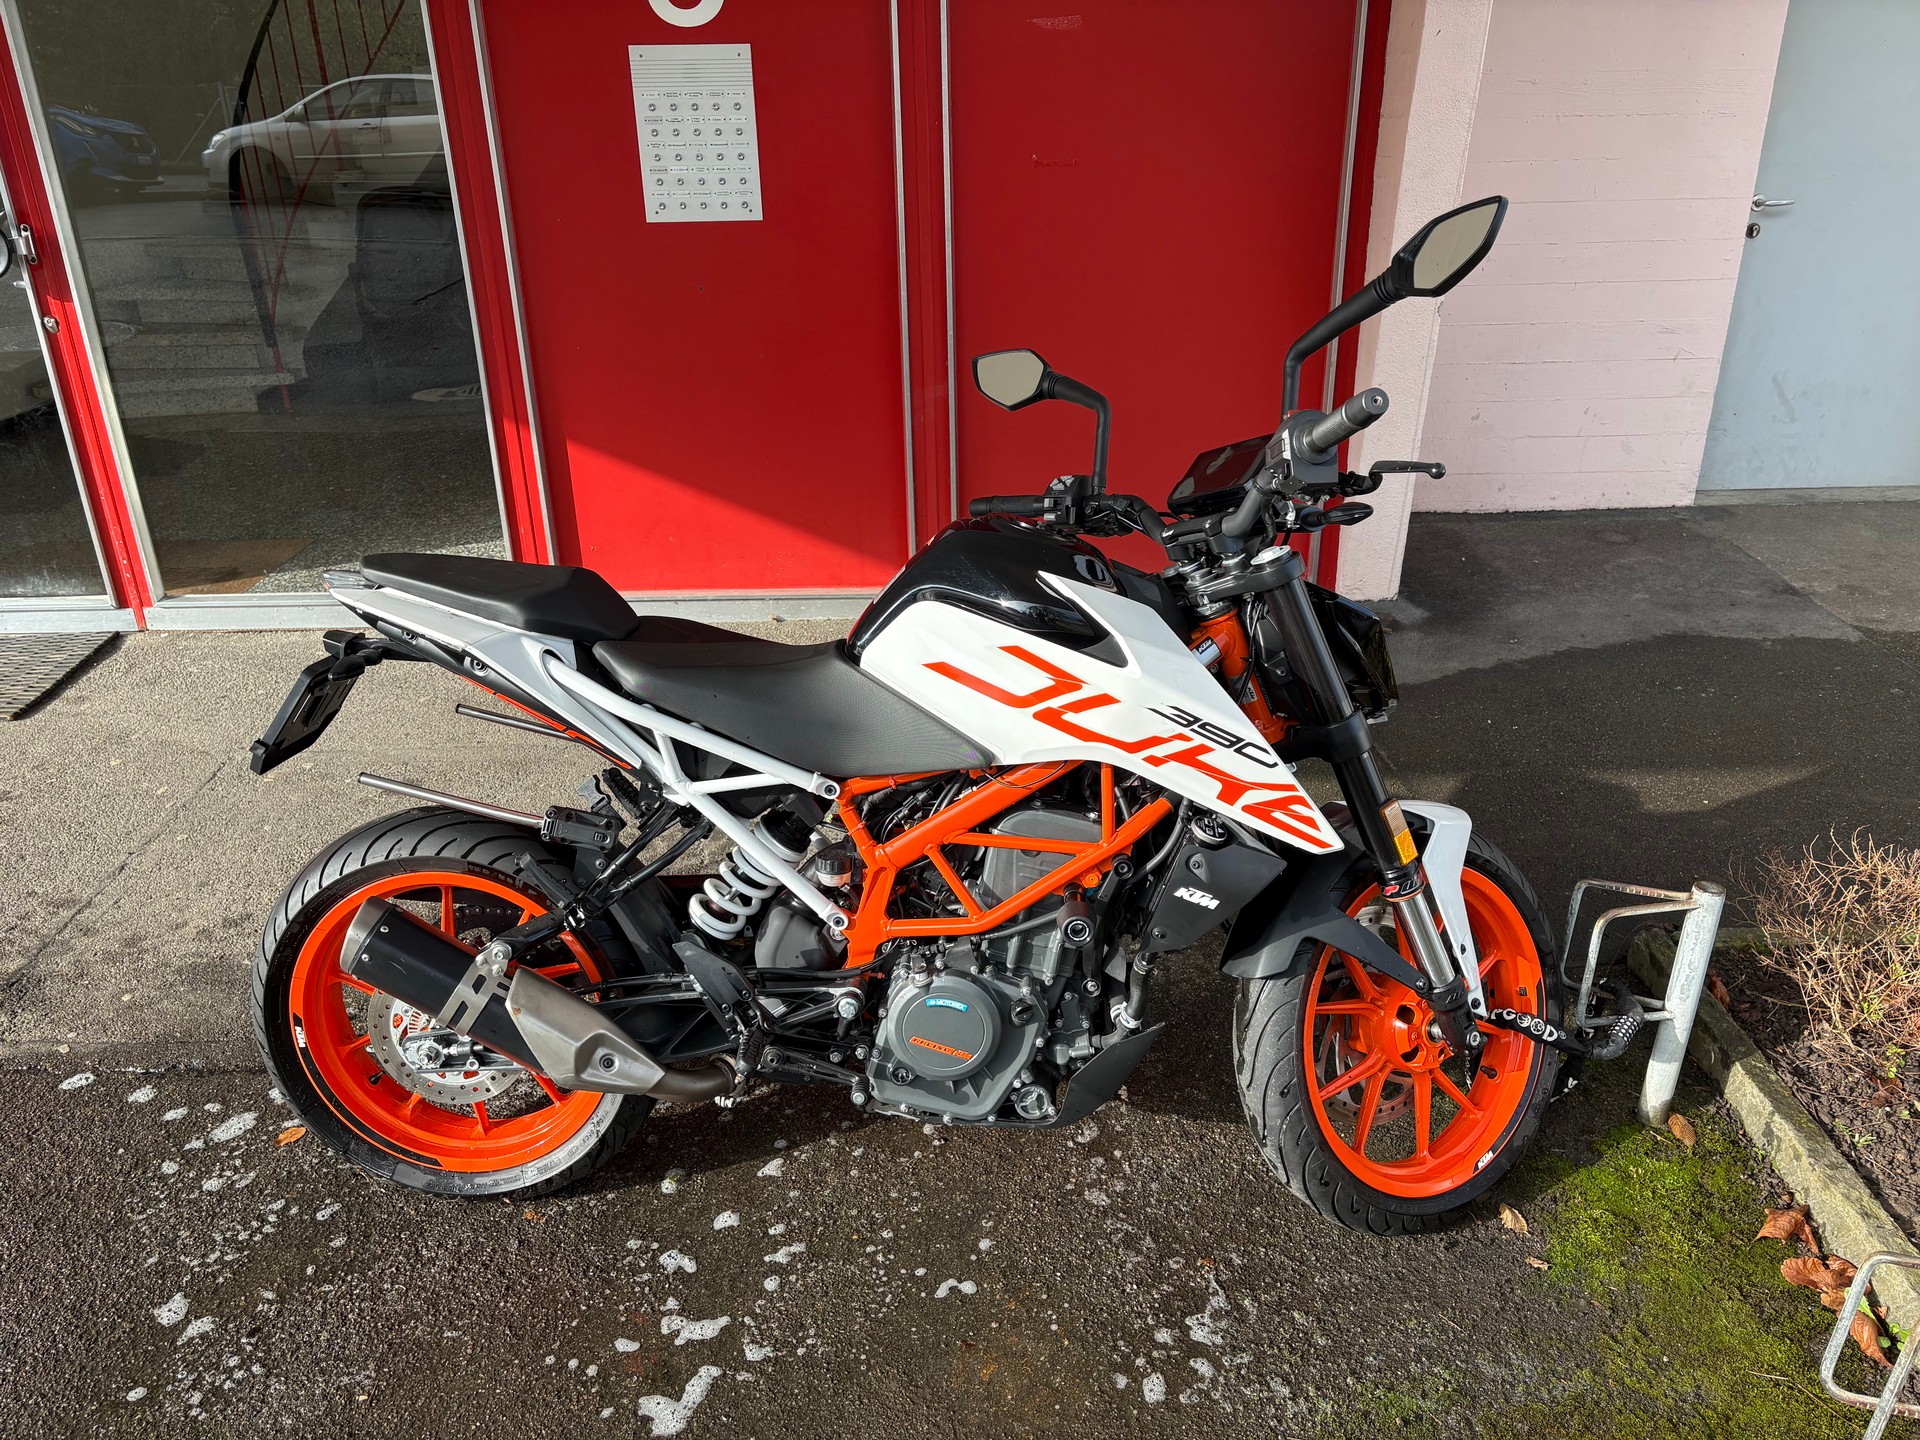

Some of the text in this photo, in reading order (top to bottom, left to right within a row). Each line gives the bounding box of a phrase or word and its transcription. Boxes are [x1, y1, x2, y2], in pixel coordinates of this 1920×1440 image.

[1198, 639, 1212, 653] KTM
[1144, 704, 1280, 769] 390
[921, 645, 1335, 849] DUKE
[1173, 887, 1220, 910] KTM
[934, 998, 965, 1011] MOTOREX
[295, 1026, 306, 1048] KTM
[910, 1037, 953, 1055] RACING
[1477, 1150, 1494, 1169] KTM
